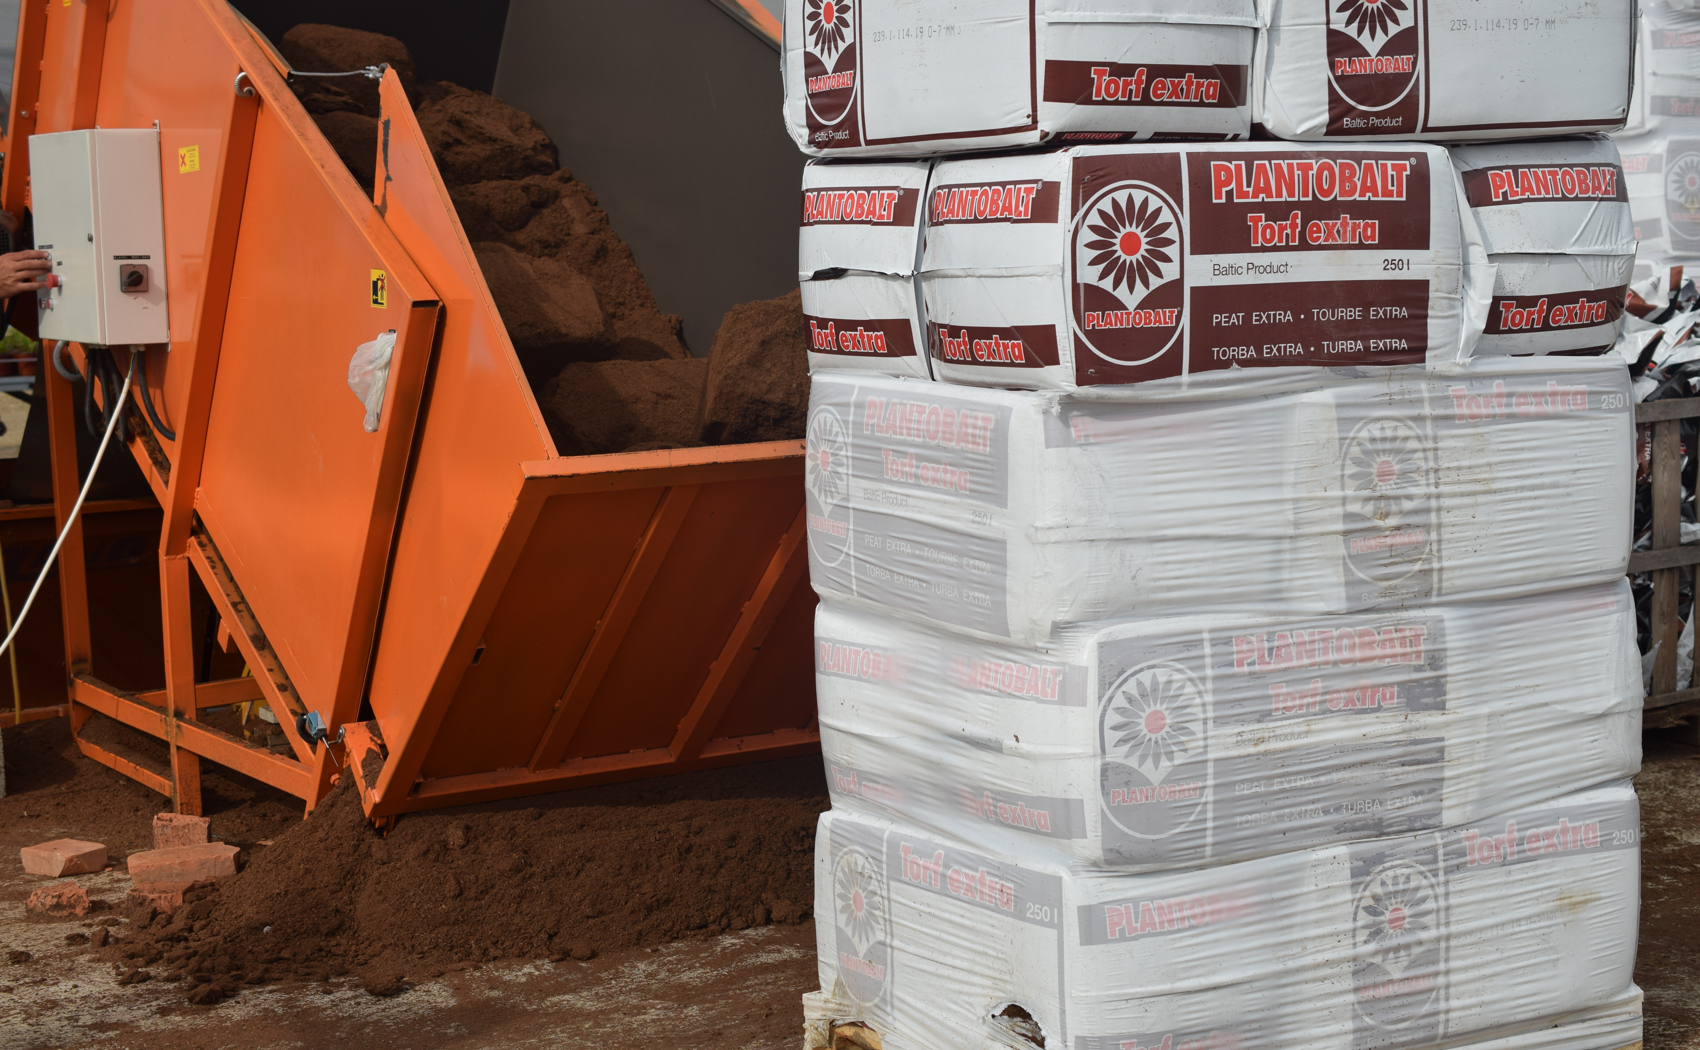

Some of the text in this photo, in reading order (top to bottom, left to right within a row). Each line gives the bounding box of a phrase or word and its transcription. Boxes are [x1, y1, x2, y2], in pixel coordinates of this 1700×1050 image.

[1545, 18, 1556, 30] MM
[1334, 54, 1415, 76] PLANTOBALT
[808, 71, 854, 94] PLANTOBALT
[1091, 67, 1220, 104] Torf extra
[828, 129, 850, 140] Product
[1343, 115, 1402, 129] Baltic Product
[1210, 159, 1410, 203] PLANTOBALT
[1488, 167, 1617, 201] PLANTOBALT
[803, 188, 898, 222] PLANTOBALT
[933, 184, 1037, 223] PLANTOBALT
[1248, 211, 1379, 247] Torf extra
[1212, 262, 1289, 276] Baltic Product
[1382, 259, 1403, 271] 250
[1085, 308, 1177, 330] PLANTOBALT
[1212, 307, 1408, 327] PEAT EXTRA TOURBE EXTRA
[1500, 298, 1607, 331] Torf extra
[809, 321, 887, 353] Torf extra
[940, 329, 1025, 363] Torf extra
[1212, 338, 1408, 361] TORBA EXTRA TURBA EXTRA
[1450, 379, 1506, 423] Torf
[1513, 380, 1588, 418] extra
[1601, 393, 1623, 410] 250
[864, 396, 995, 455] PLANTOBALT
[1644, 431, 1652, 460] EXTRA
[882, 448, 969, 494] Torf extra
[881, 491, 908, 508] Product
[809, 513, 847, 538] PLANTOBALT
[865, 534, 991, 575] PEAT EXTRA TOURBE EXTRA
[865, 564, 891, 581] TORBA
[931, 582, 959, 599] TURBA
[963, 590, 992, 607] EXTRA
[1233, 624, 1427, 671] PLANTOBALT
[1269, 678, 1397, 715] Torf extra
[831, 765, 858, 796] Torf
[1110, 782, 1201, 806] PLANTOBALT
[997, 801, 1051, 833] extra
[1341, 799, 1382, 814] TURBA
[1461, 820, 1517, 867] Torf
[1525, 818, 1600, 855] extra
[1612, 829, 1634, 845] 250
[900, 842, 944, 889] Torf
[947, 867, 1014, 912] extra
[1026, 902, 1050, 922] 250
